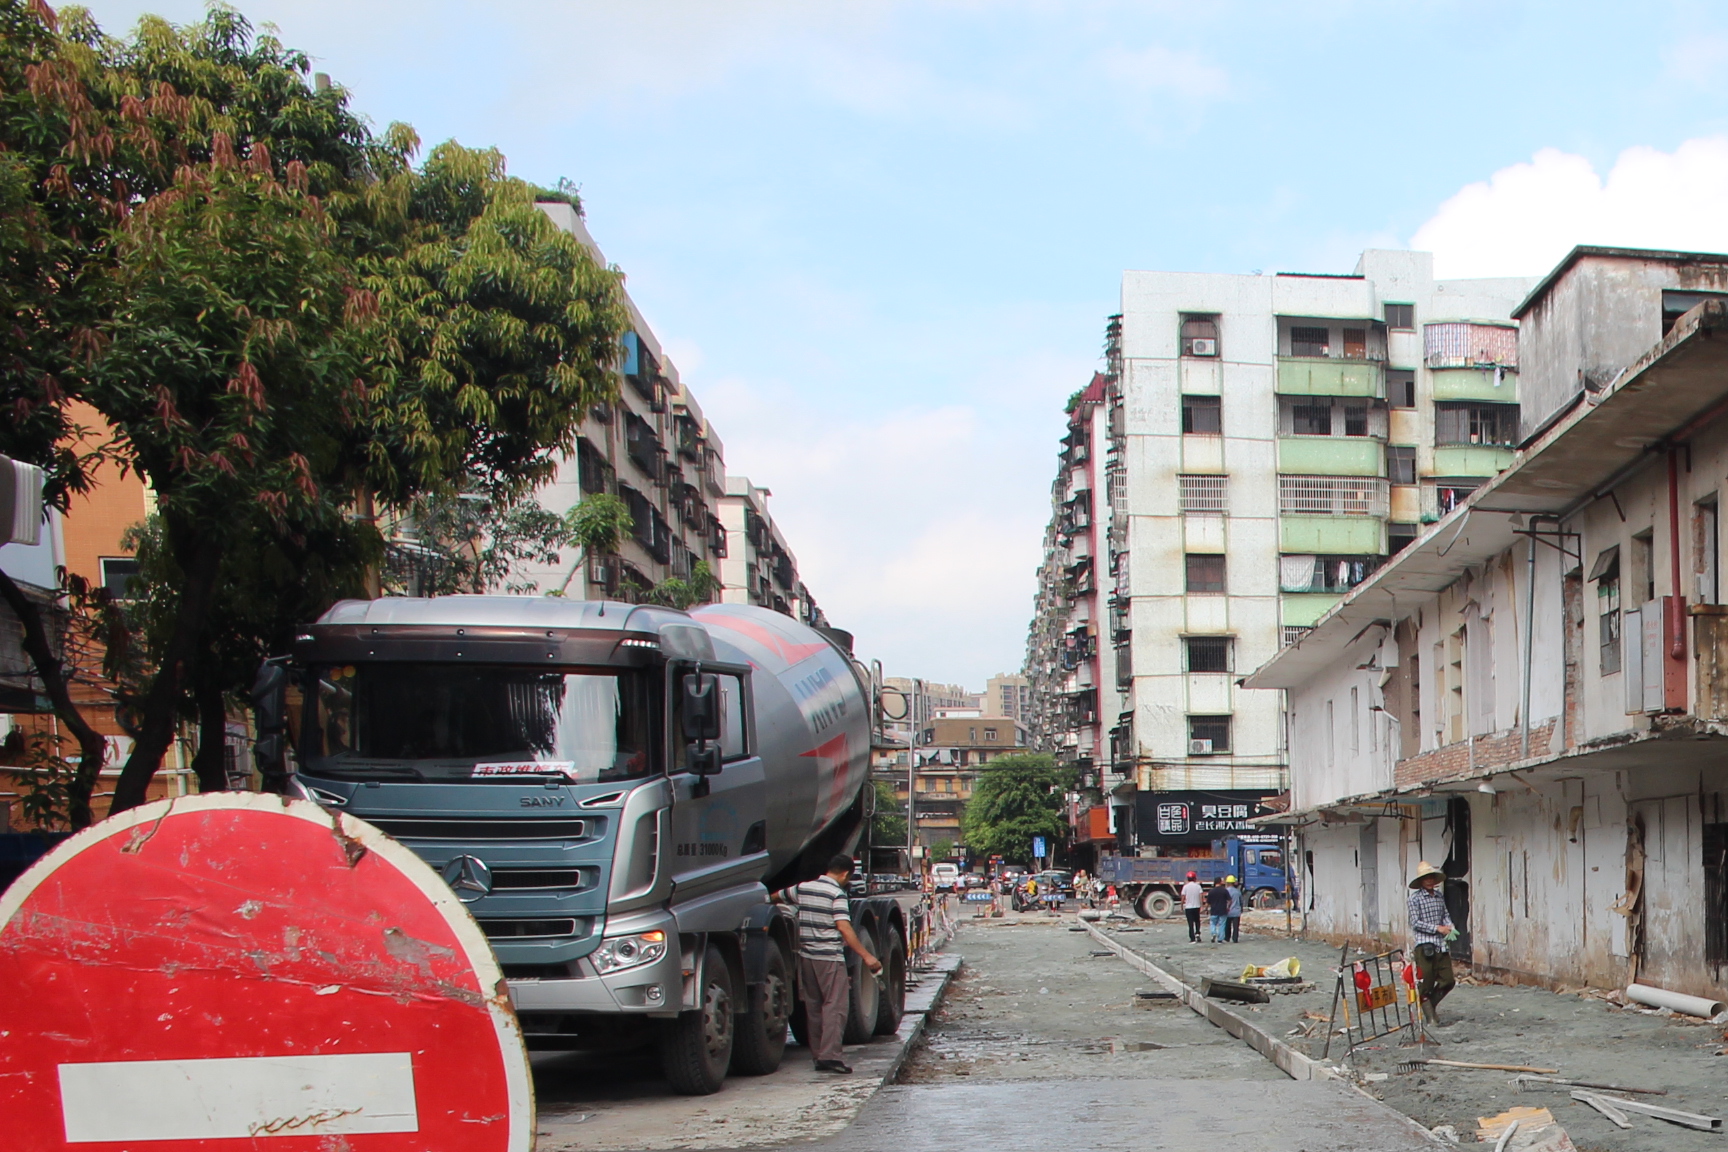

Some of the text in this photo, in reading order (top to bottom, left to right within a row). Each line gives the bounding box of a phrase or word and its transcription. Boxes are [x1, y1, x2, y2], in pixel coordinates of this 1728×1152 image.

[519, 795, 565, 808] SANY
[1201, 804, 1248, 818] 臭豆腐
